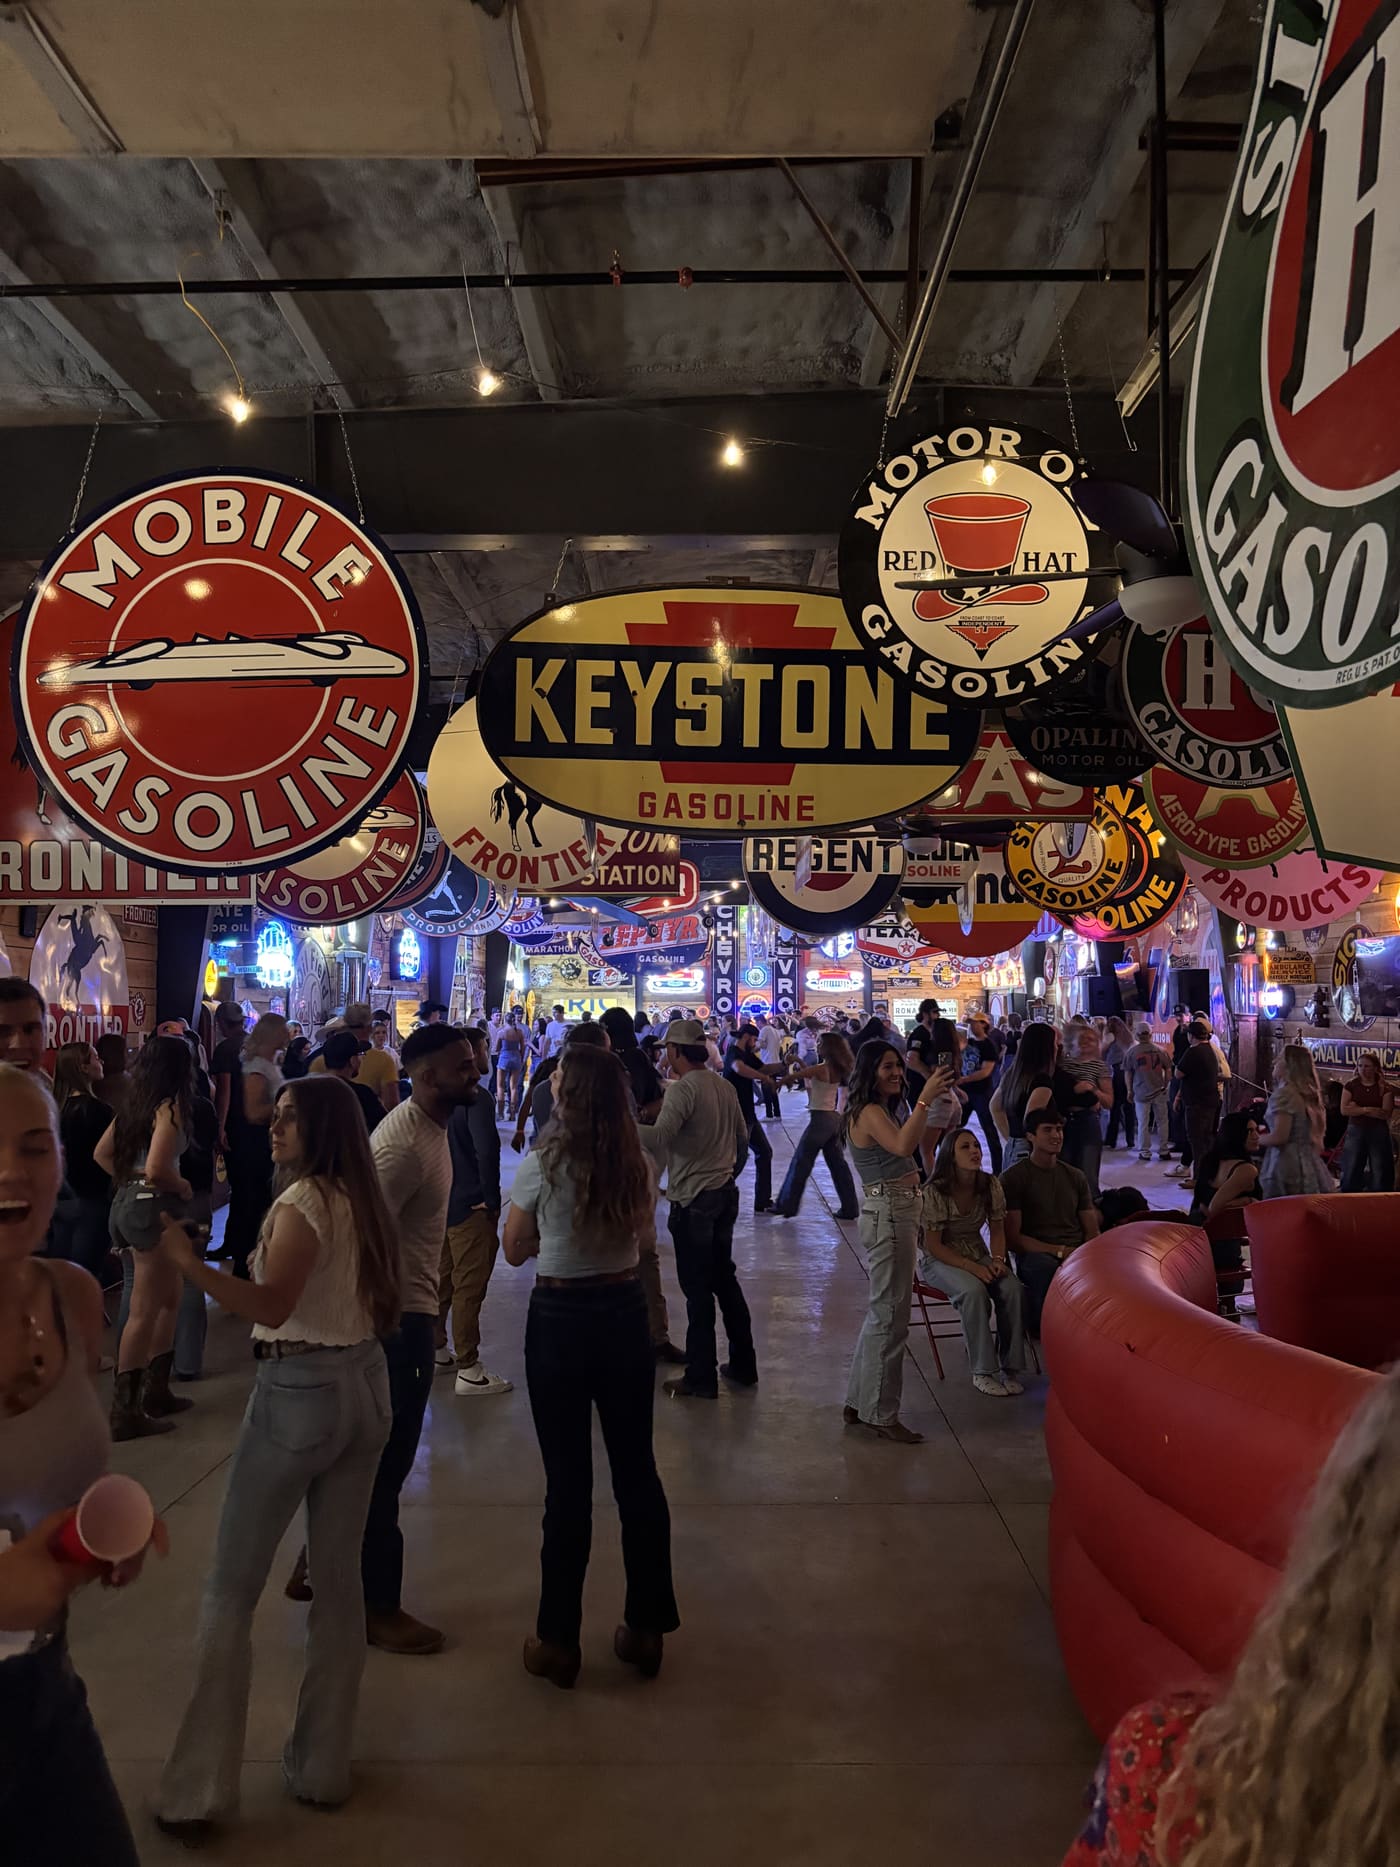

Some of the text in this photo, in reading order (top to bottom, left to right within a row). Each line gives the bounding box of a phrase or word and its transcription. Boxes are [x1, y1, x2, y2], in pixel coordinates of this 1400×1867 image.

[854, 427, 1022, 531] MOTOR
[59, 489, 373, 609] MOBILE
[884, 551, 1077, 574] RED HAT
[1206, 438, 1400, 664] GASO
[515, 657, 950, 750] KEYSTONE
[1031, 726, 1149, 752] OPALIN
[1139, 701, 1286, 780] GASOLI
[48, 697, 398, 851] GASOLINE
[1042, 754, 1145, 767] MOTOR OIL
[638, 791, 815, 822] GASOLINE
[1160, 794, 1241, 856] AERO-TYPE
[452, 827, 616, 884] FRONTIER
[753, 838, 898, 875] REGENT
[580, 864, 677, 887] STATION
[1017, 858, 1124, 907] GASOLINE
[1201, 864, 1372, 923] PRODUCTS
[124, 905, 158, 924] FRONTIER
[231, 923, 249, 932] OIL
[406, 906, 482, 934] PRODUCTS
[525, 944, 578, 955] MARATHON
[600, 917, 699, 951] ZEPHYR
[639, 954, 686, 964] GASOLINE
